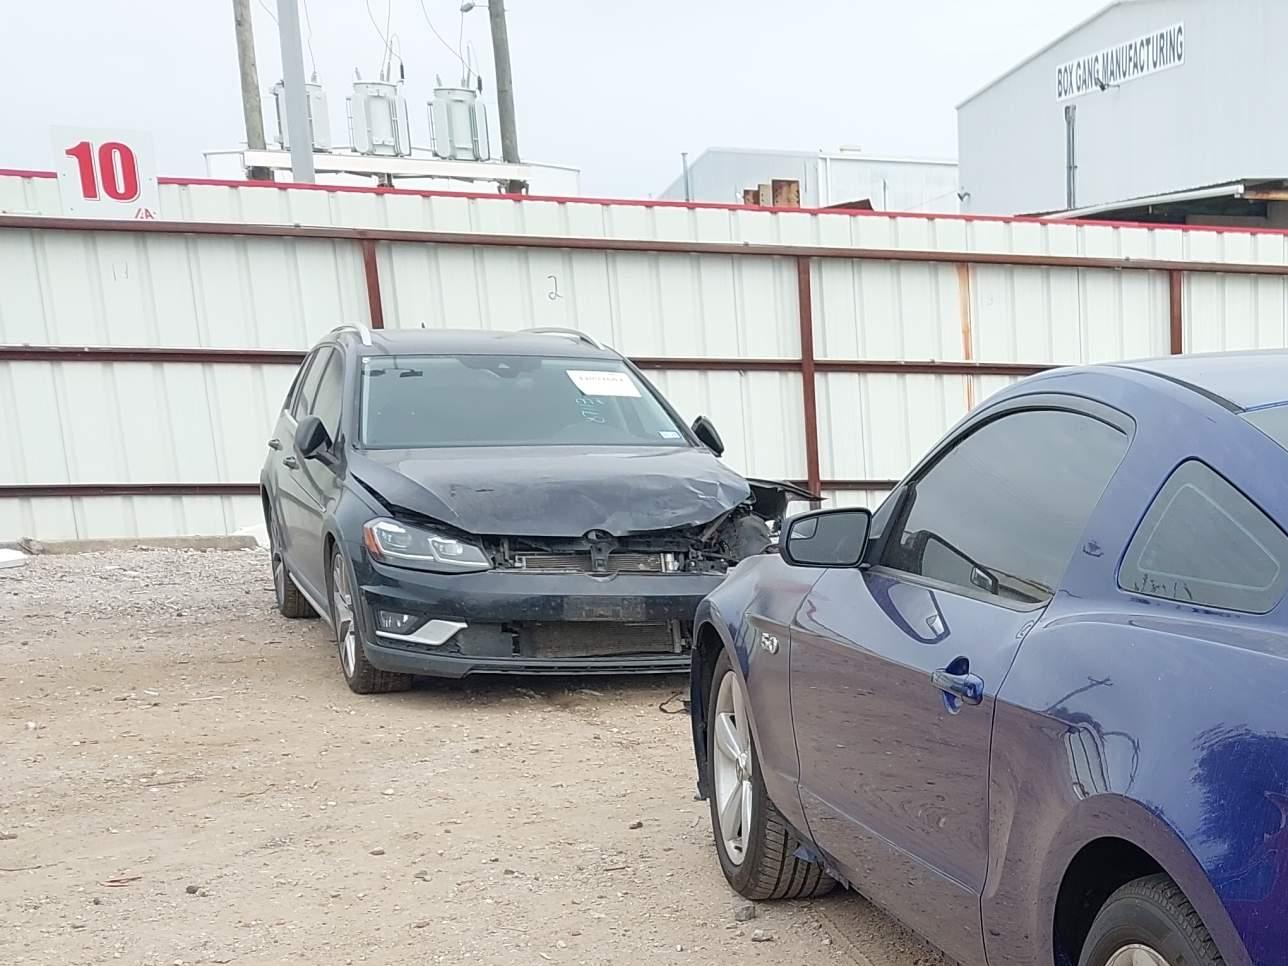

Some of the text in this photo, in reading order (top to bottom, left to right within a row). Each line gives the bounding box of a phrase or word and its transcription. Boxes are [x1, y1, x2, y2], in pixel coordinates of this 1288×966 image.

[1057, 26, 1184, 98] BOX GANG MANUFACTURING
[65, 141, 138, 201] 10
